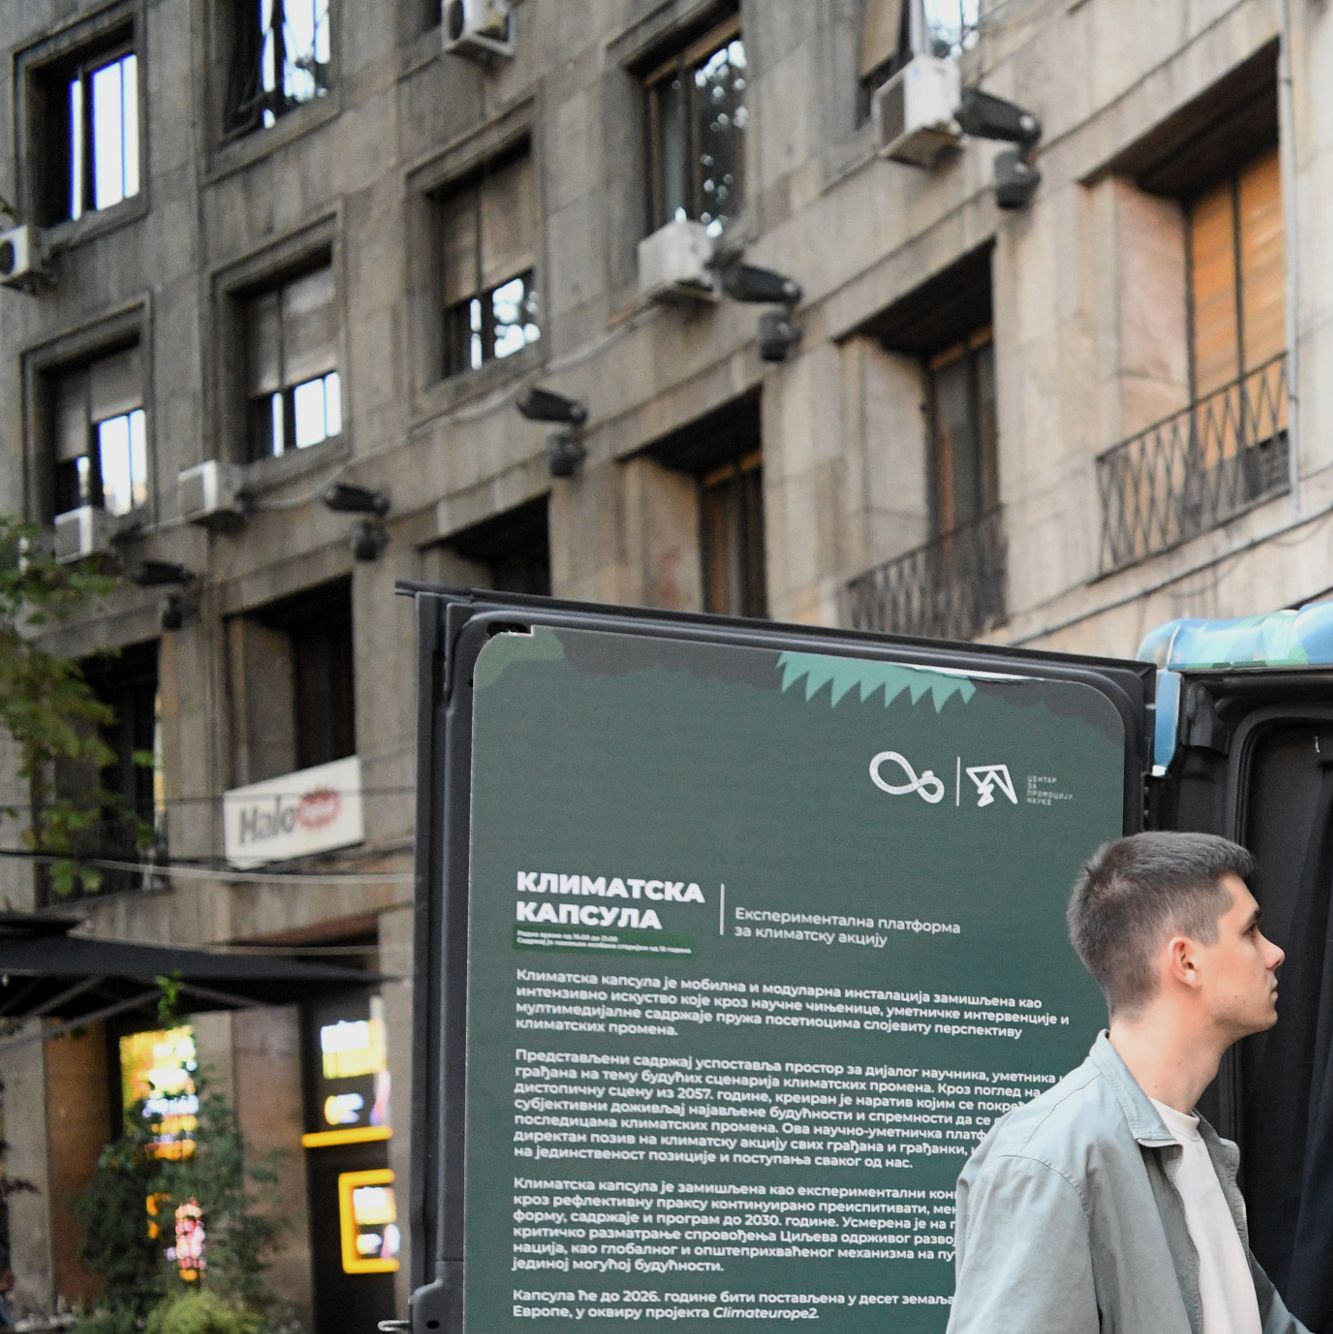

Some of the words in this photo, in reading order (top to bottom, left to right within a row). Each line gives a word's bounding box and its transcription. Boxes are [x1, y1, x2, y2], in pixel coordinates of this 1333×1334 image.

[516, 870, 705, 903] КЛИМАТСКА
[515, 900, 662, 930] КАПСУЛА
[734, 906, 874, 928] Експериментална
[877, 918, 960, 934] платформа
[734, 925, 752, 937] за
[754, 927, 835, 945] климатску
[837, 931, 888, 948] акцију
[516, 968, 598, 984] Климатска
[600, 975, 661, 989] капсула
[661, 975, 678, 991] је
[680, 977, 746, 992] мобилна
[748, 983, 759, 993] и
[761, 983, 841, 998] модуларна
[844, 988, 930, 1004] инсталација
[932, 993, 1015, 1007] замишљена
[1018, 998, 1042, 1009] као
[515, 986, 608, 1001] интензивно
[610, 991, 678, 1005] искуство
[680, 992, 711, 1008] које
[713, 996, 748, 1009] кроз
[750, 998, 803, 1012] научне
[804, 1001, 884, 1016] чињенице,
[885, 1006, 960, 1019] уметничке
[963, 1010, 1057, 1026] интервенције
[1059, 1015, 1069, 1025] и
[515, 1002, 642, 1019] мултимедијалне
[643, 1008, 713, 1024] садржаје
[715, 1012, 762, 1026] пружа
[764, 1014, 861, 1029] посетиоцима
[862, 1018, 932, 1035] слојевиту
[933, 1023, 1023, 1040] перспективу
[515, 1018, 605, 1032] климатских
[608, 1022, 678, 1036] промена.
[515, 1047, 630, 1065] Представљени
[632, 1055, 693, 1070] садржај
[694, 1058, 782, 1072] успоставља
[784, 1061, 844, 1076] простор
[846, 1065, 862, 1075] за
[864, 1063, 919, 1079] дијалог
[921, 1068, 990, 1082] научника,
[991, 1071, 1056, 1083] уметника
[514, 1064, 578, 1080] грађана
[580, 1069, 599, 1080] на
[601, 1069, 638, 1084] тему
[640, 1068, 703, 1085] будућих
[704, 1074, 780, 1089] сценарија
[782, 1077, 867, 1090] климатских
[869, 1081, 935, 1093] промена.
[937, 1082, 971, 1096] Кроз
[973, 1085, 1022, 1098] поглед
[513, 1082, 606, 1098] дистопичну
[607, 1085, 654, 1100] сцену
[656, 1088, 675, 1099] из
[676, 1086, 714, 1100] 2057.
[716, 1090, 772, 1103] године,
[774, 1092, 837, 1106] креиран
[837, 1092, 853, 1107] је
[855, 1096, 913, 1108] наратив
[915, 1096, 955, 1111] којим
[957, 1100, 974, 1110] се
[510, 1255, 569, 1272] јединој
[572, 1257, 631, 1273] могућој
[633, 1257, 724, 1273] будућности.
[512, 1288, 575, 1304] Капсула
[577, 1288, 598, 1301] ће
[599, 1291, 620, 1303] до
[622, 1289, 661, 1302] 2026.
[663, 1292, 717, 1304] године
[719, 1290, 755, 1303] бити
[758, 1293, 845, 1304] постављена
[847, 1294, 857, 1306] у
[857, 1294, 899, 1305] десет
[512, 1304, 573, 1319] Европе,
[575, 1307, 585, 1320] у
[586, 1307, 642, 1320] оквиру
[644, 1305, 710, 1320] пројекта
[712, 1305, 819, 1321] Climateurope2.
